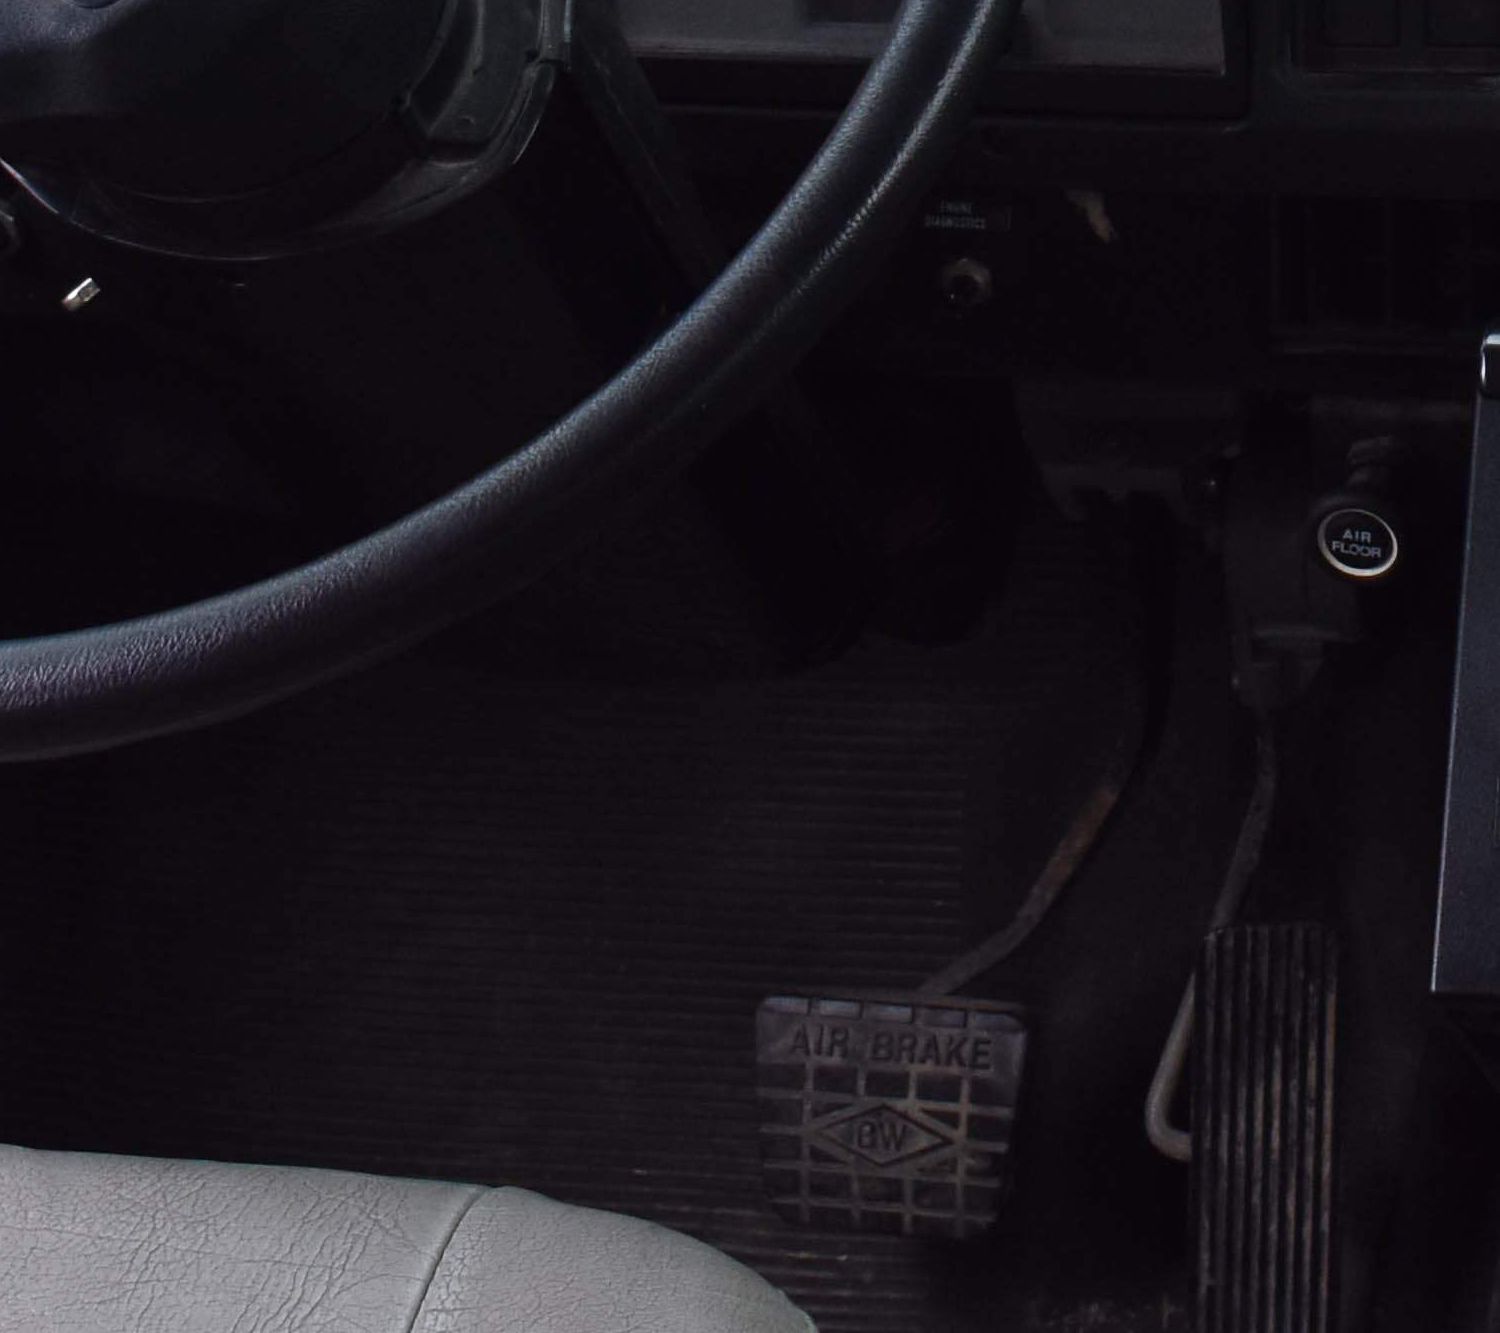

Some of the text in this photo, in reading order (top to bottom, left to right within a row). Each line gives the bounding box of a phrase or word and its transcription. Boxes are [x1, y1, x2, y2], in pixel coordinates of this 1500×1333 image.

[1342, 530, 1371, 543] AIR
[1332, 541, 1381, 558] FLOOR
[788, 1025, 996, 1070] AIR BRAKE
